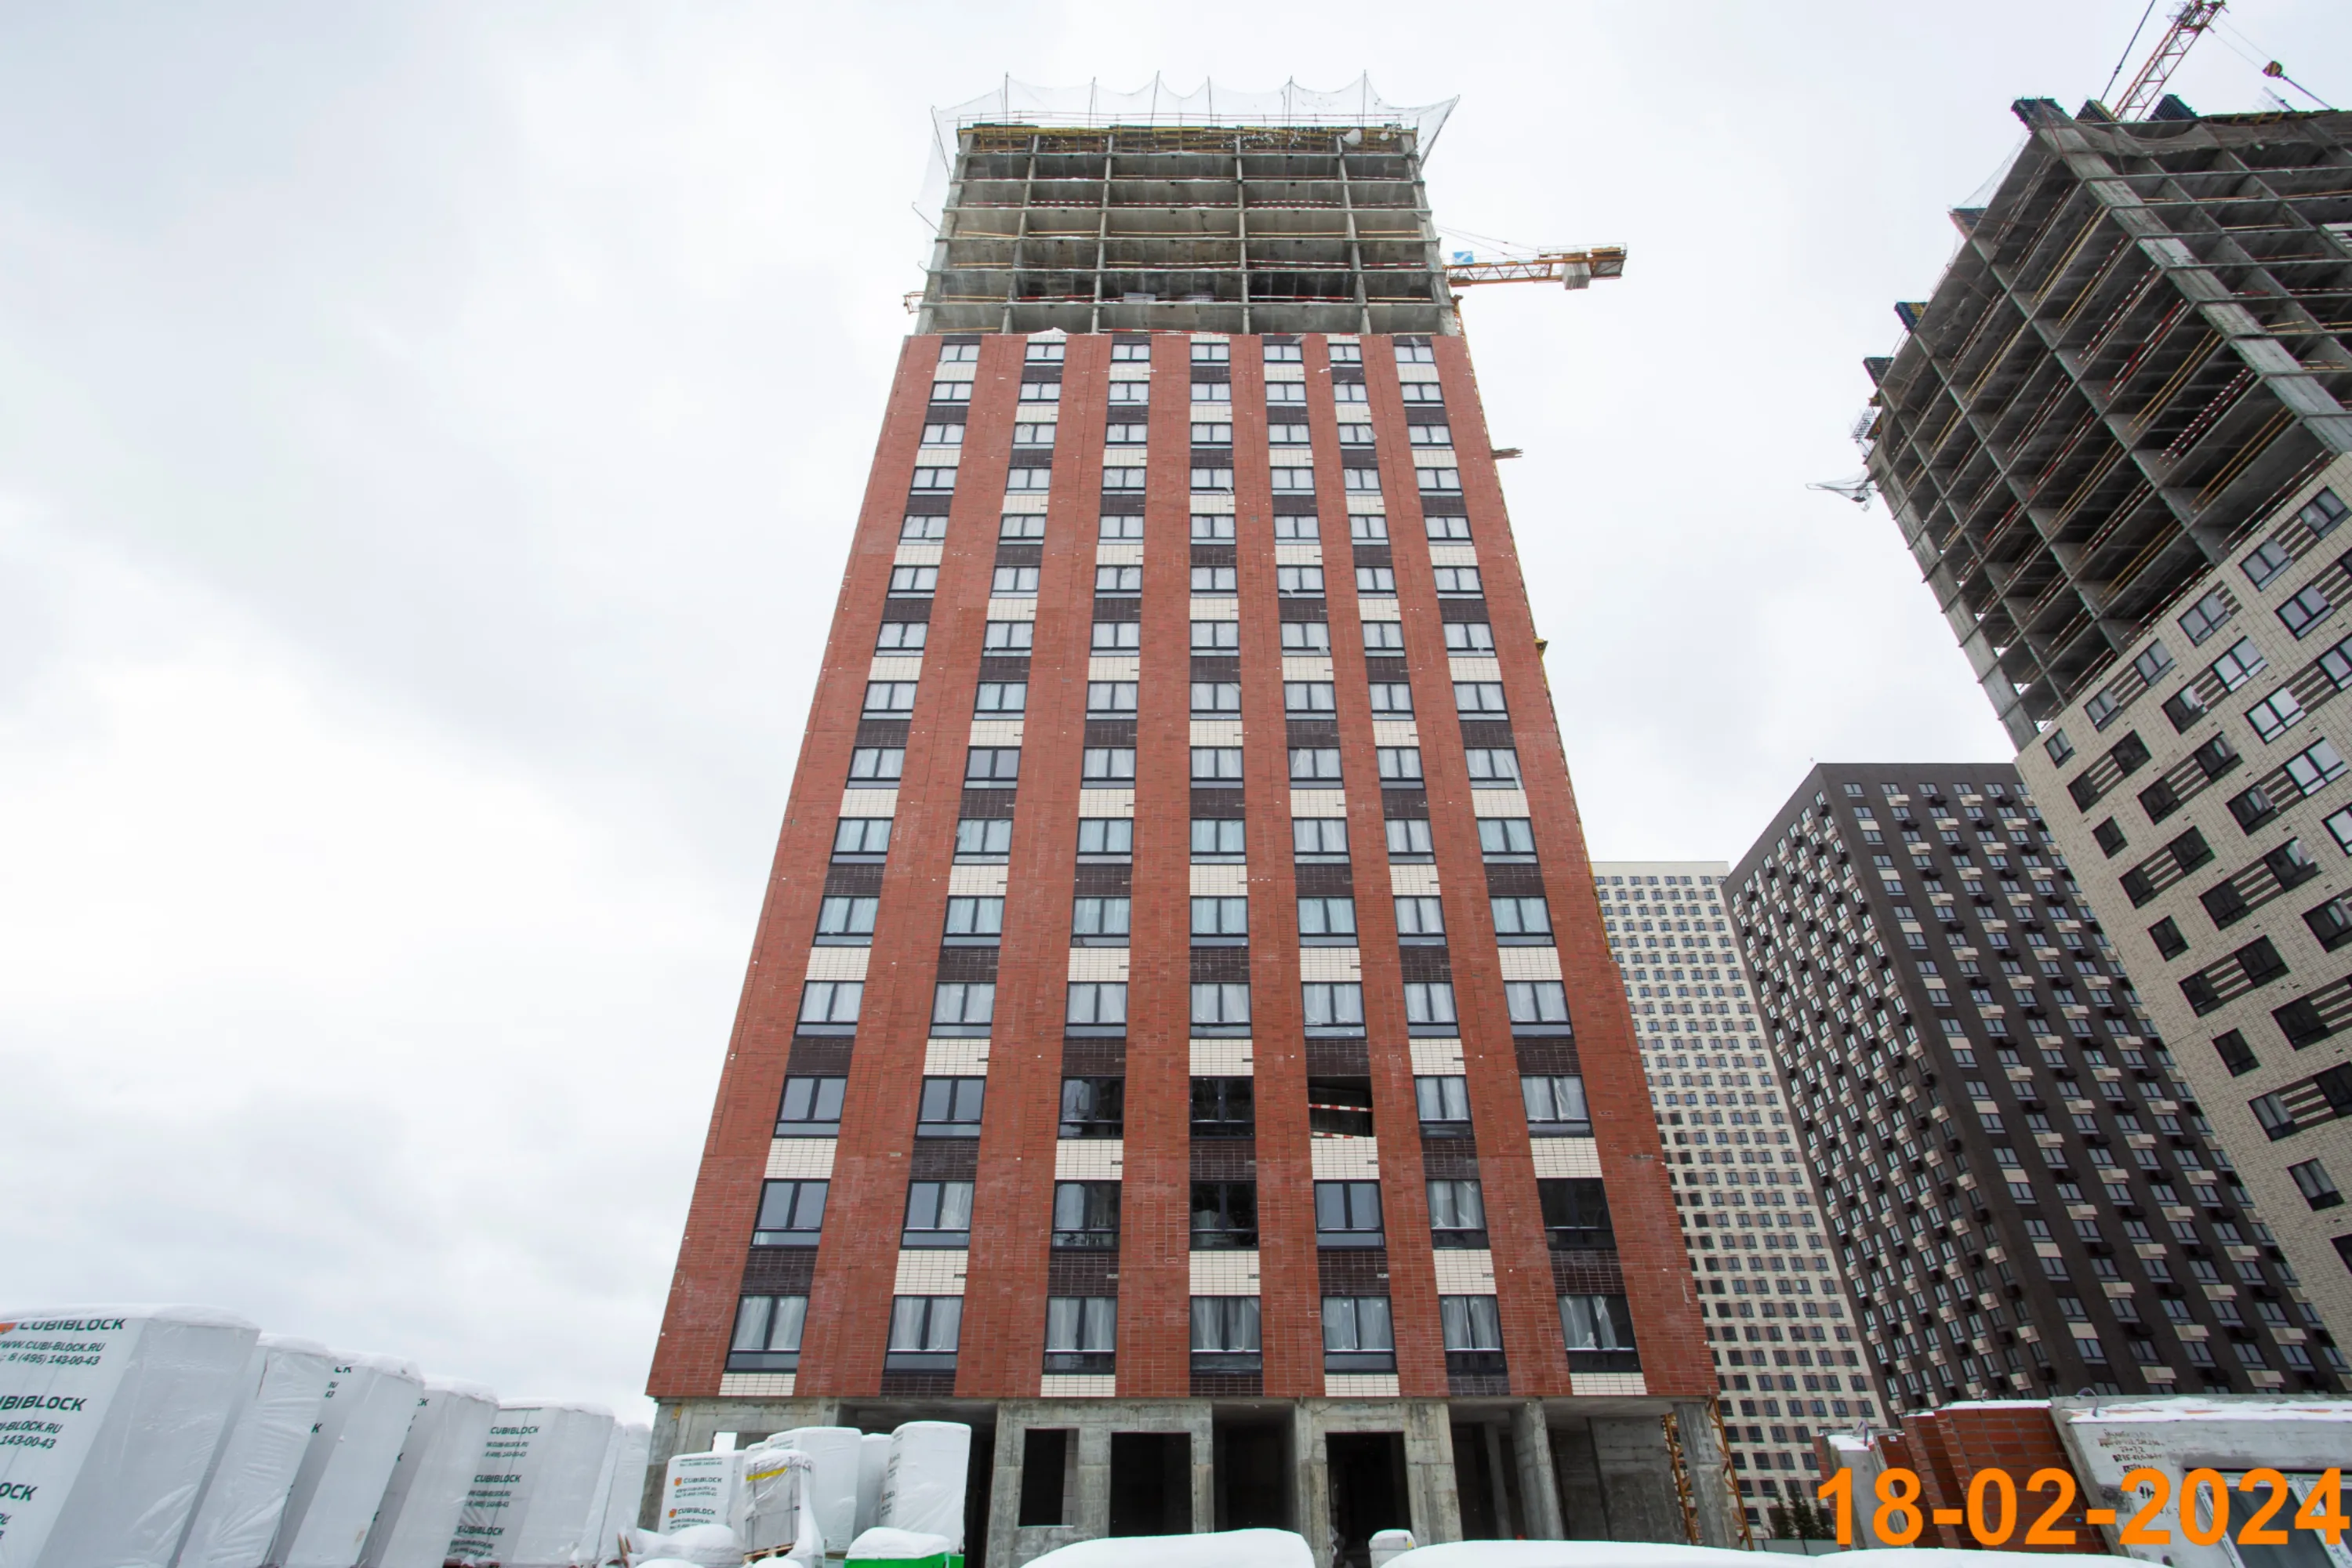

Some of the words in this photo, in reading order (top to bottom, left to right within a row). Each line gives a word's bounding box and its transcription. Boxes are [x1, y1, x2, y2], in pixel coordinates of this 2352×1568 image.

[19, 1319, 128, 1331] CUBIBLOCK
[17, 1353, 47, 1365] (495)
[48, 1355, 101, 1366] 143-00-43
[490, 1426, 539, 1435] CUBIBLOCK
[0, 1435, 57, 1449] 143-00-43
[474, 1474, 522, 1483] CUBIBLOCK
